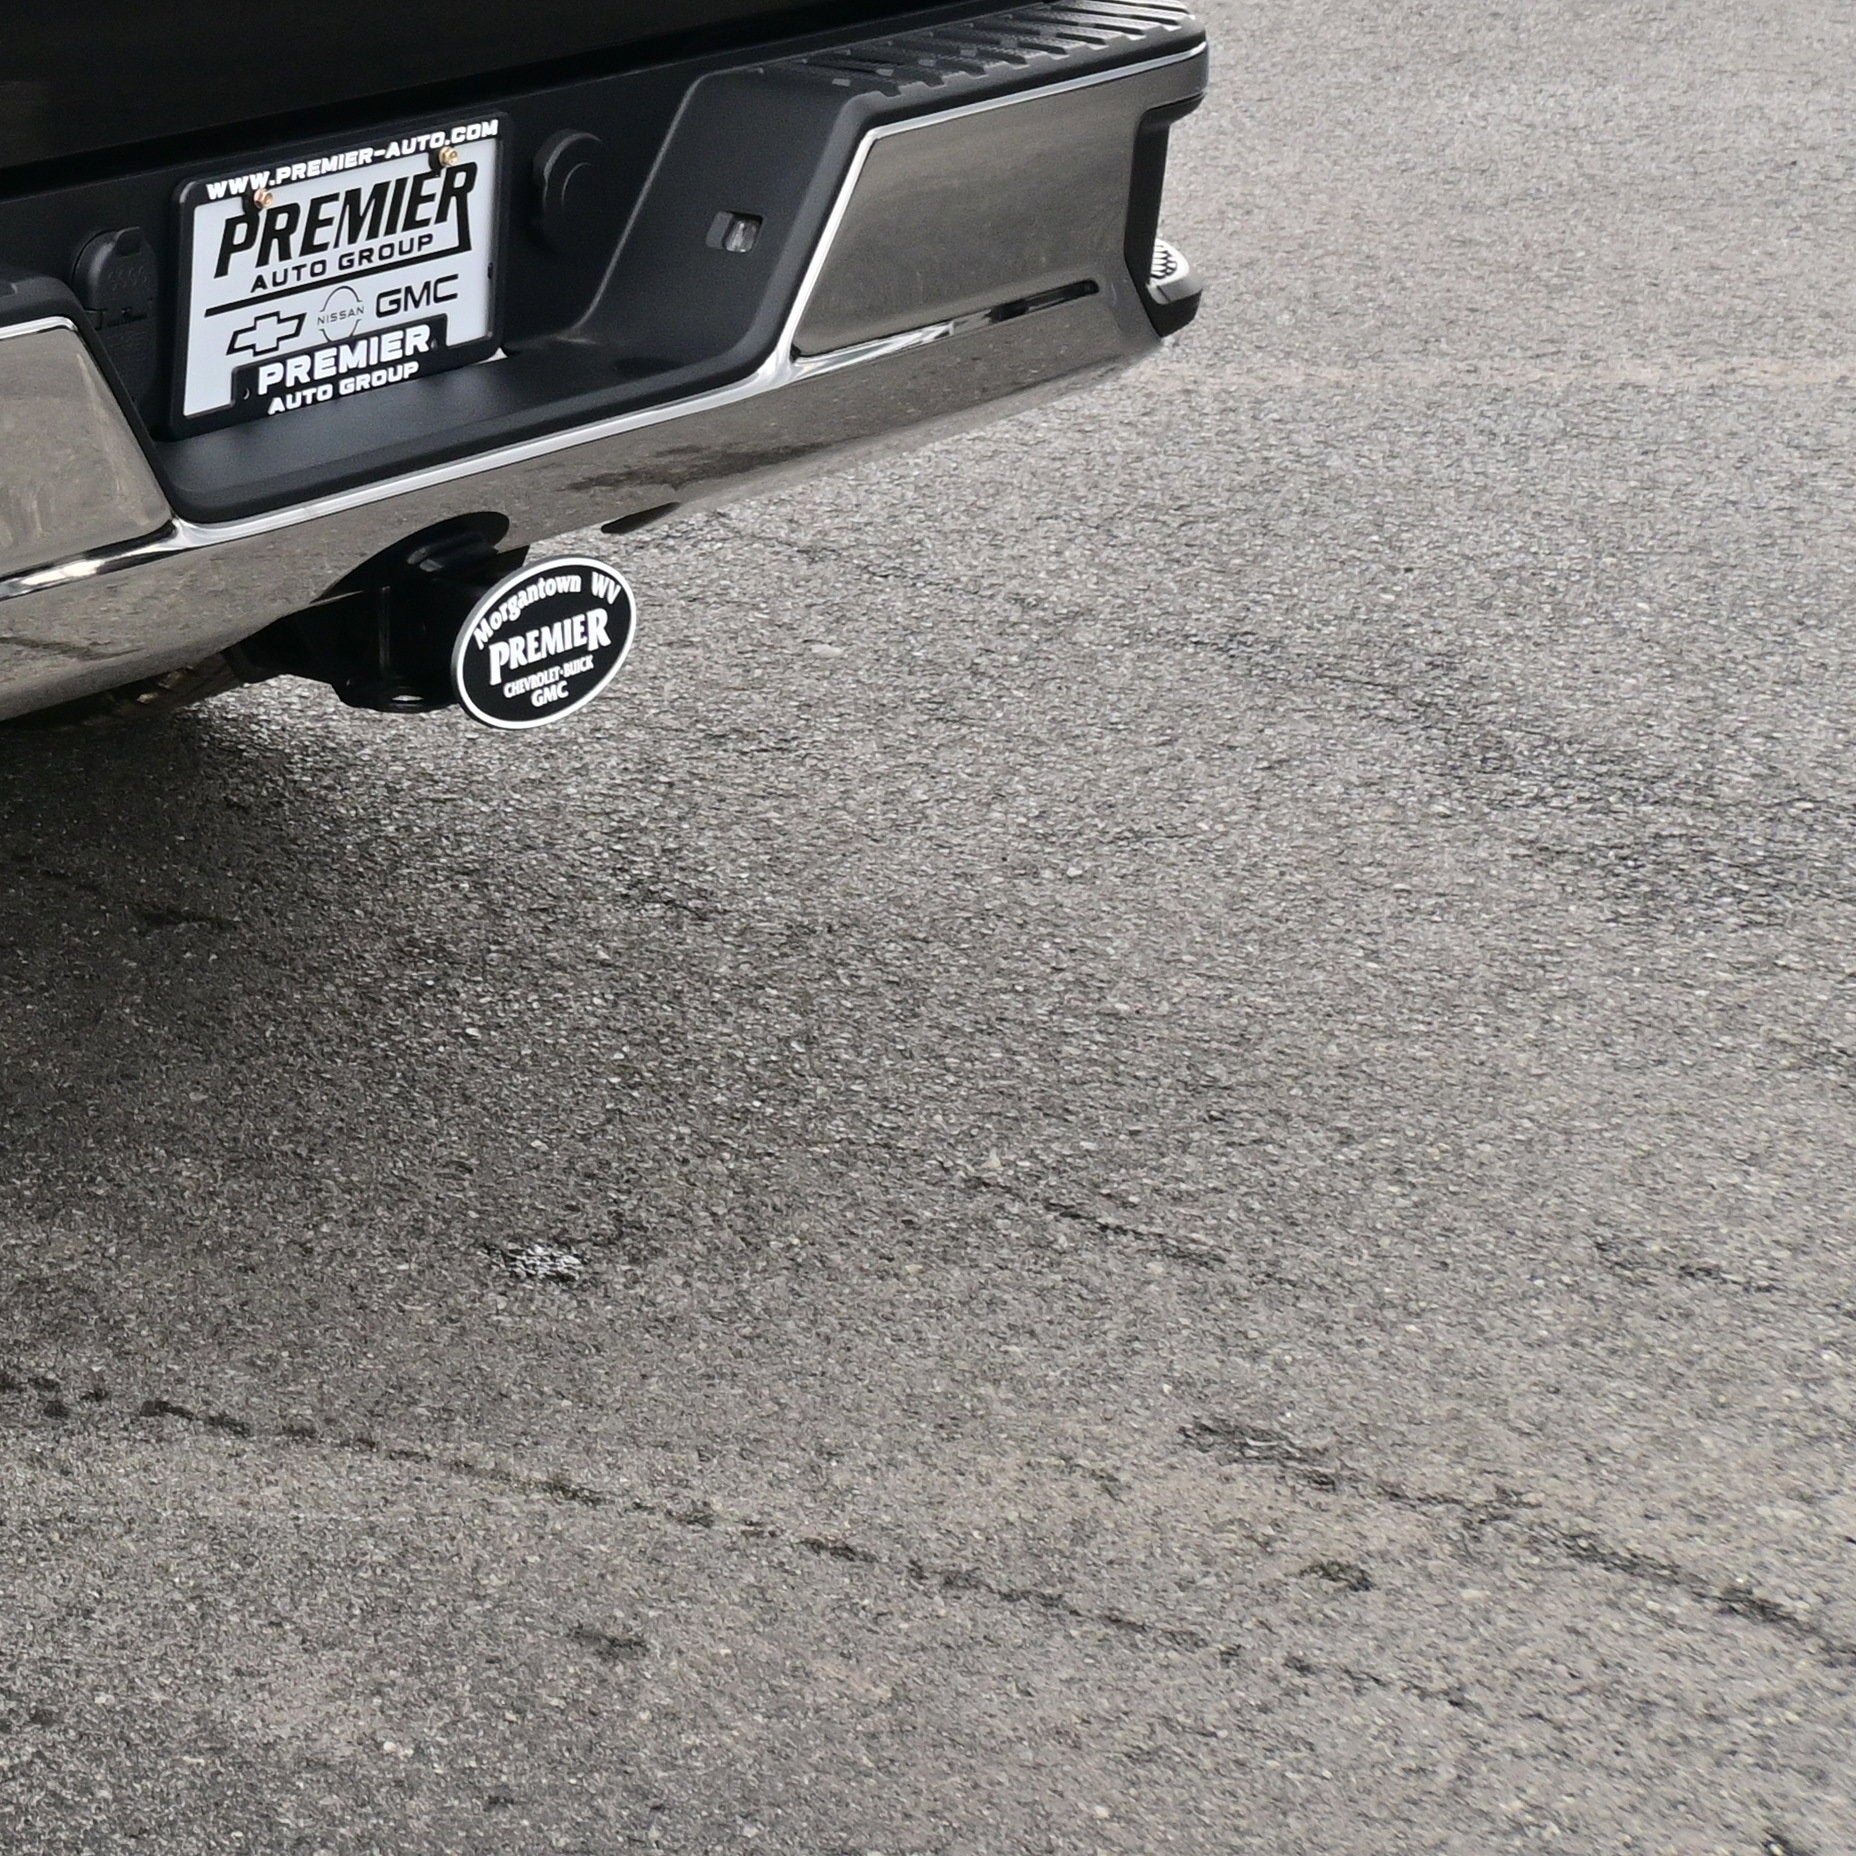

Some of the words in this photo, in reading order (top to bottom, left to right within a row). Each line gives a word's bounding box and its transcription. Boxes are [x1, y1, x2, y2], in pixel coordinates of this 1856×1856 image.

[206, 119, 499, 201] WWW.PREMIER-AUTO.COM
[214, 161, 478, 279] PREMIER
[250, 258, 327, 293] AUTO
[338, 233, 434, 271] GROUP
[317, 305, 365, 326] NISSAN
[376, 273, 460, 318] GMC
[257, 324, 431, 396] PREMIER
[267, 383, 333, 416] AUTO
[339, 361, 420, 395] GROUP
[473, 574, 582, 651] Morgantown
[591, 571, 622, 605] WV
[489, 608, 612, 685] PREMIER
[531, 680, 569, 707] GMC
